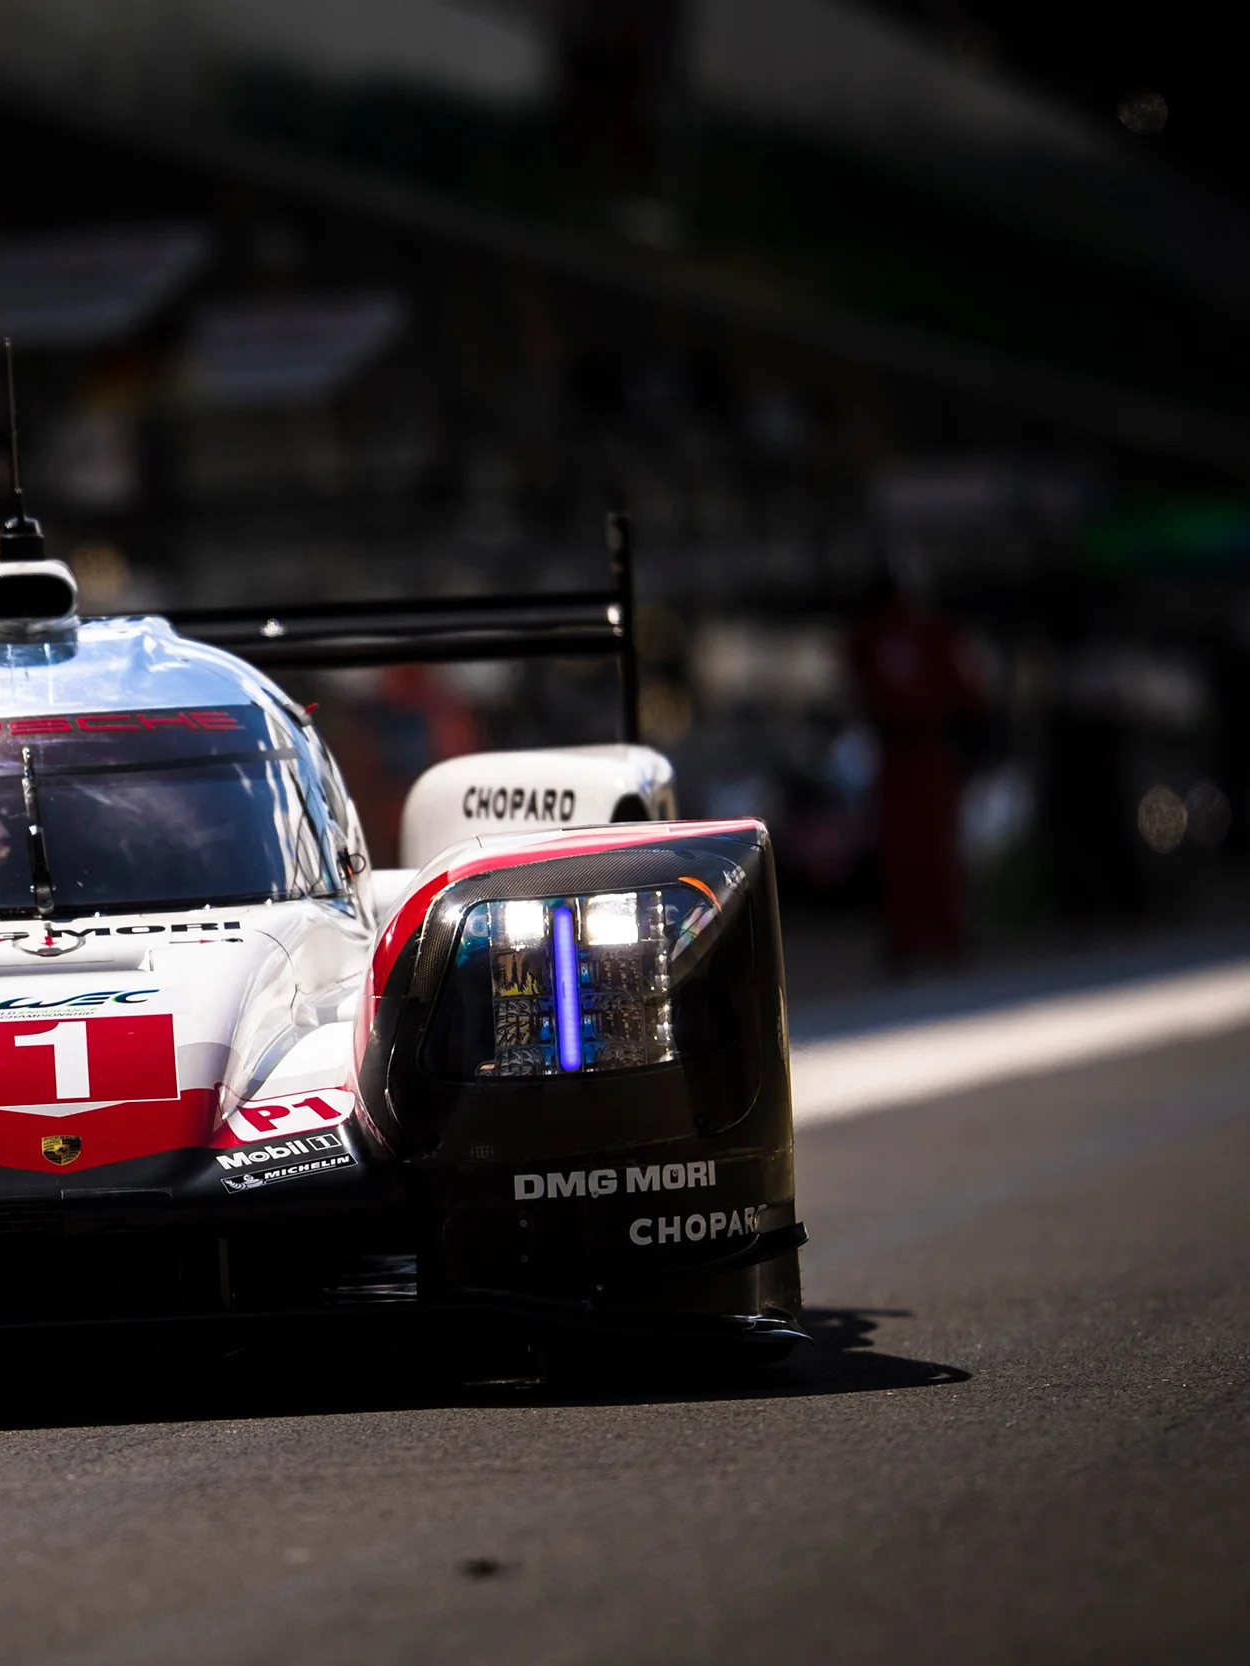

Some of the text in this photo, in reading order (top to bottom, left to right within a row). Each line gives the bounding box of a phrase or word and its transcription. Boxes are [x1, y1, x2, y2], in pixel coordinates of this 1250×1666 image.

[462, 786, 575, 821] CHOPARD
[47, 921, 241, 938] MORI
[0, 1011, 95, 1020] CHAMPIONSHIP
[18, 1007, 98, 1015] ENDURANCE
[14, 1021, 90, 1100] 1
[240, 1096, 342, 1133] P1
[215, 1139, 309, 1170] Mobil
[264, 1155, 350, 1180] MICHELIN
[513, 1160, 717, 1201] DMG MORI
